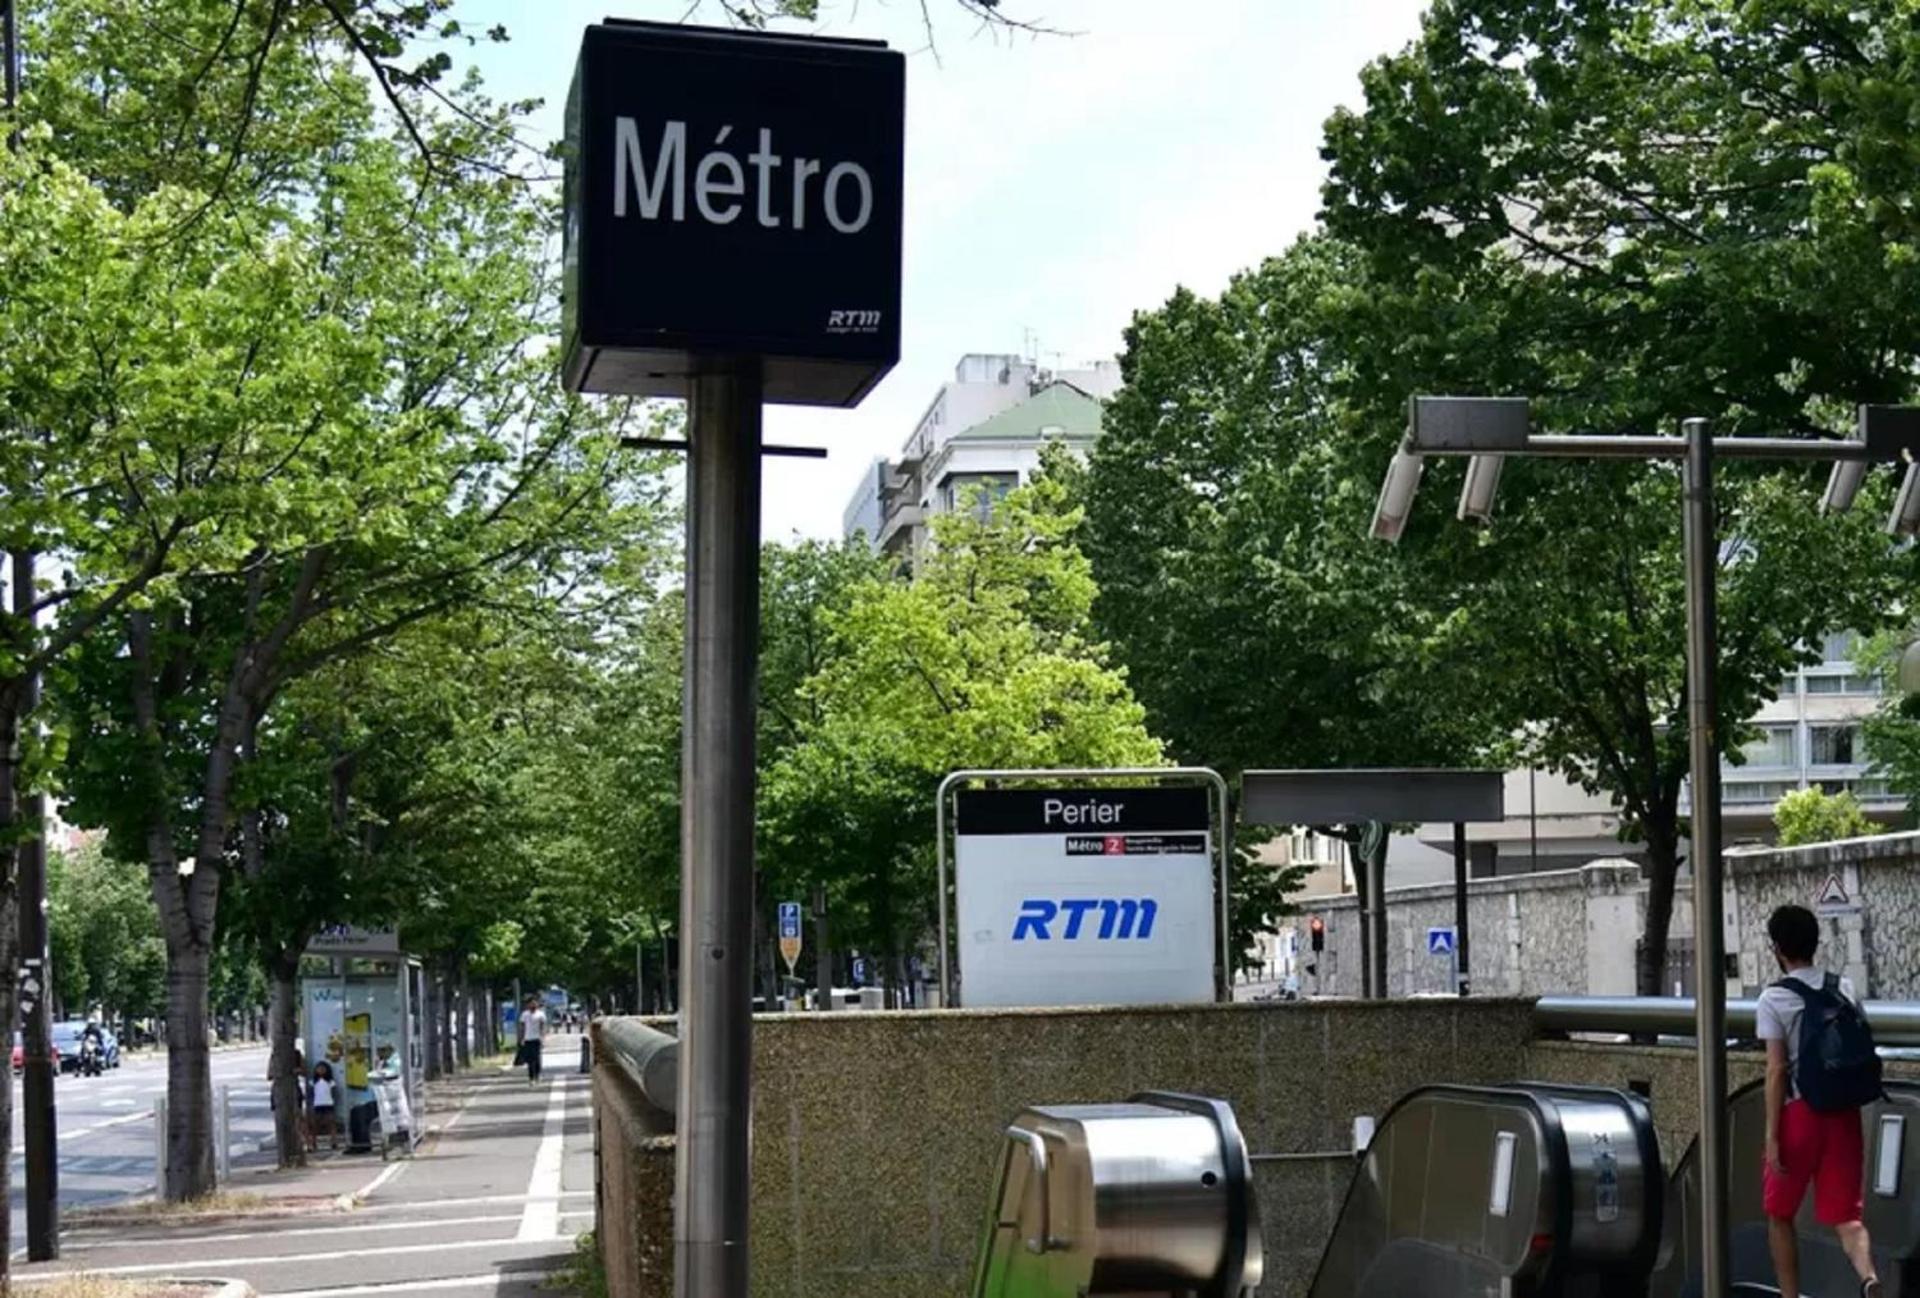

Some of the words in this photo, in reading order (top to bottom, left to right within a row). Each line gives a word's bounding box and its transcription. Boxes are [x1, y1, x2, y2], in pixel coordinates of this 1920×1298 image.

[614, 116, 873, 233] Métro
[828, 310, 881, 326] RTM
[1044, 799, 1124, 824] Perier
[1068, 839, 1103, 851] Métro
[1109, 838, 1120, 852] 2
[1012, 899, 1158, 940] RTM
